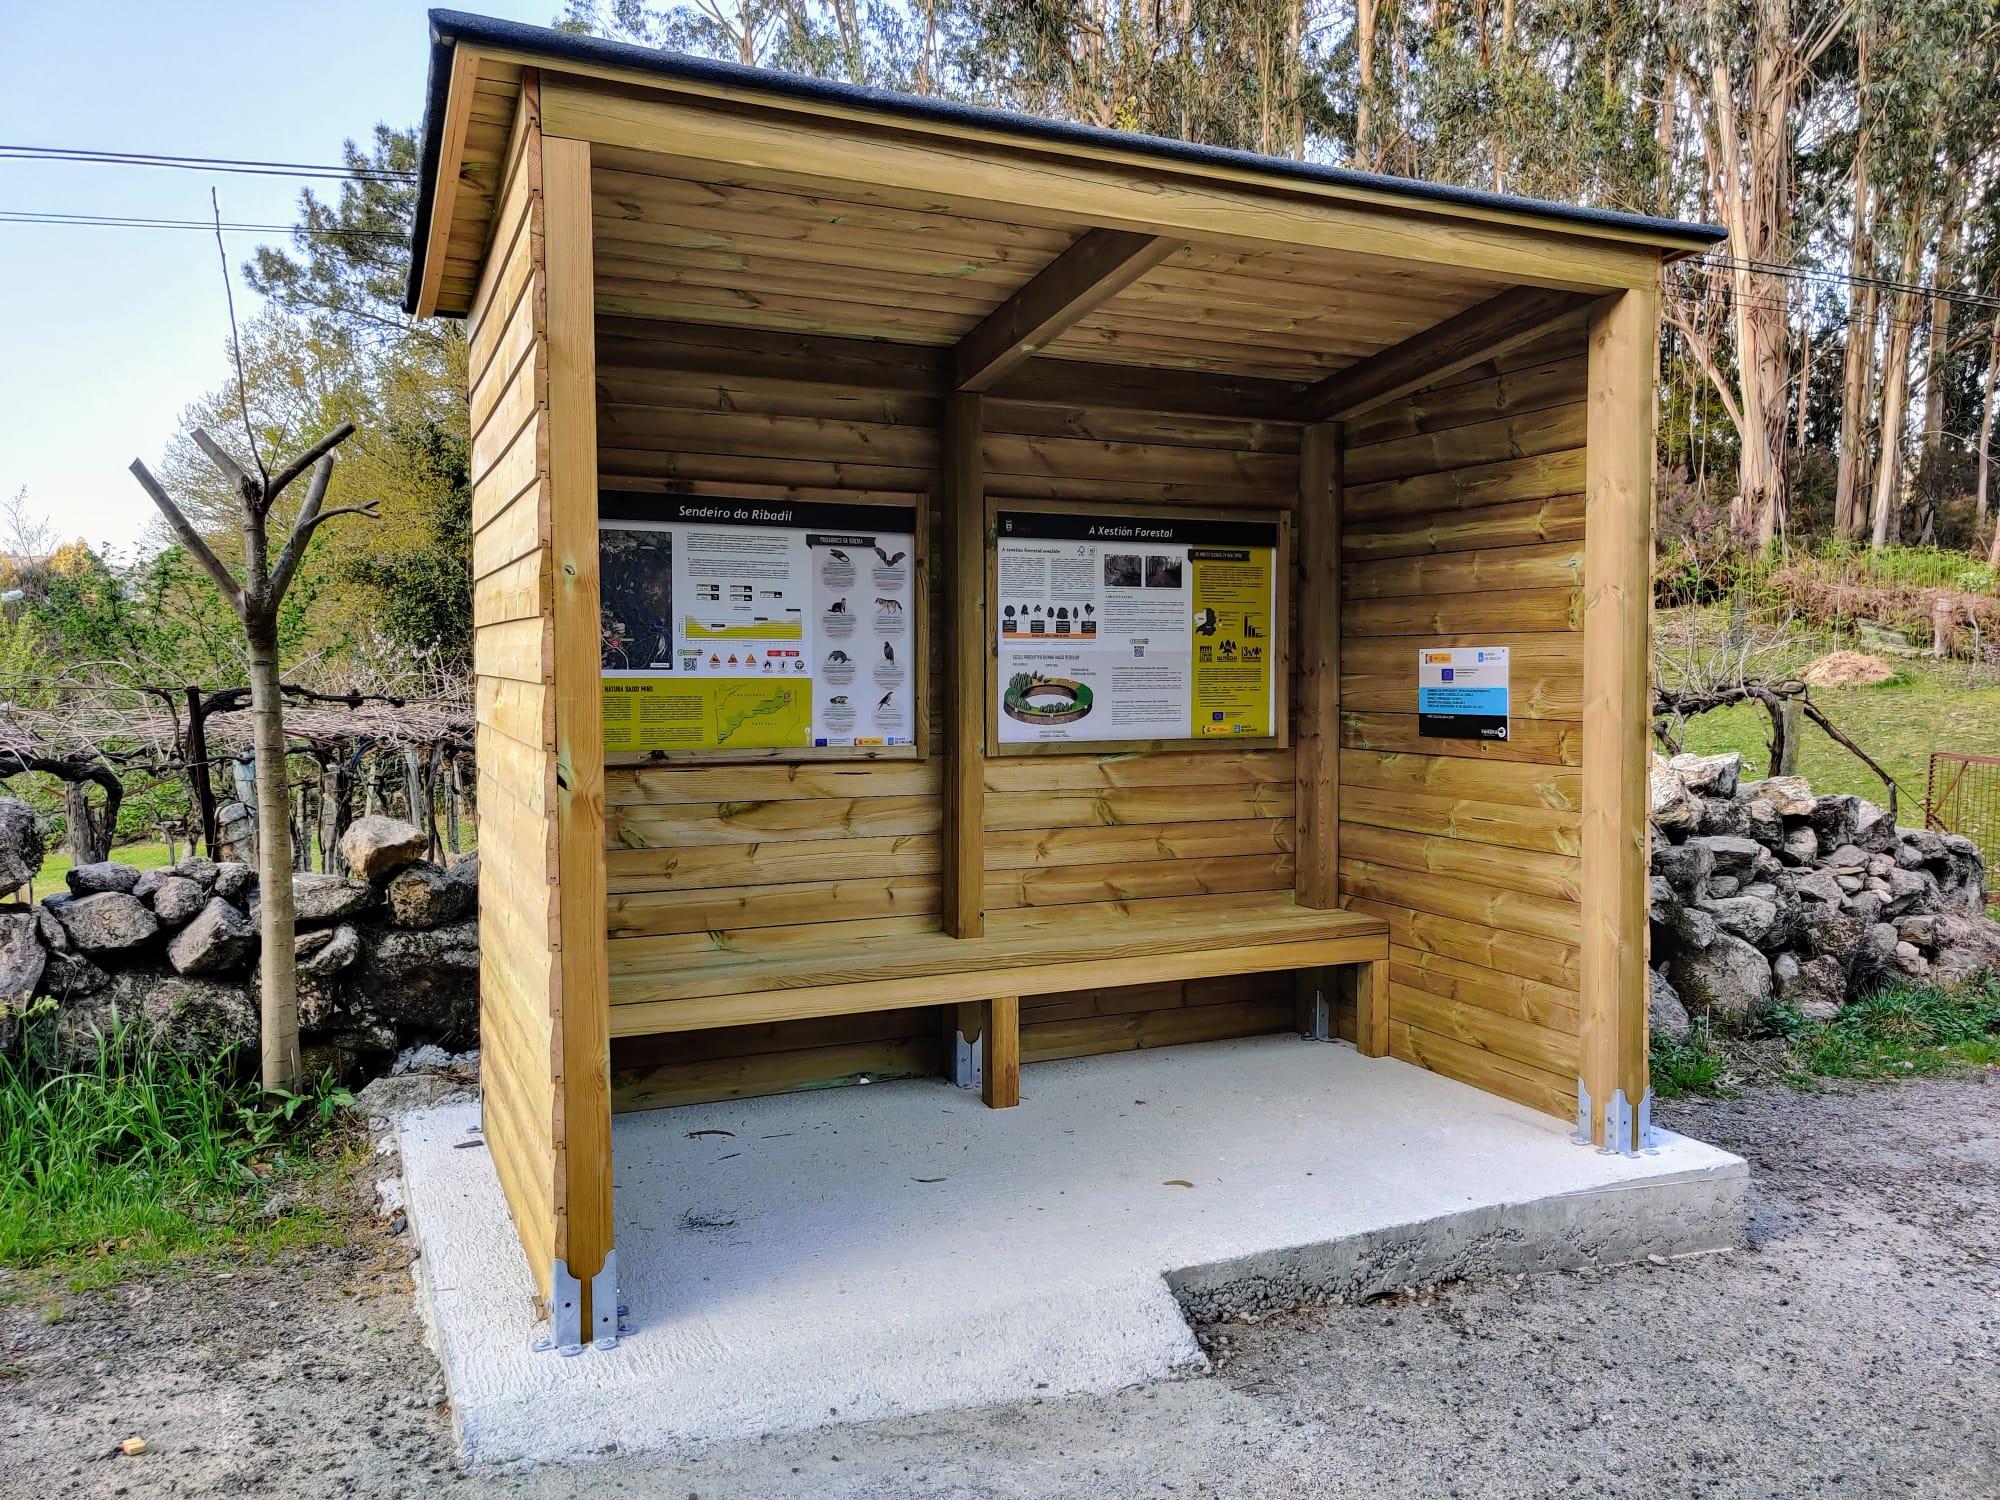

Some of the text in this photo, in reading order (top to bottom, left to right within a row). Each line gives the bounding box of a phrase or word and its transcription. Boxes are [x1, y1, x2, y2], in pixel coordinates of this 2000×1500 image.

[679, 505, 793, 522] Sendeiro do Ribadil
[1088, 526, 1173, 538] A Xestión Forestal
